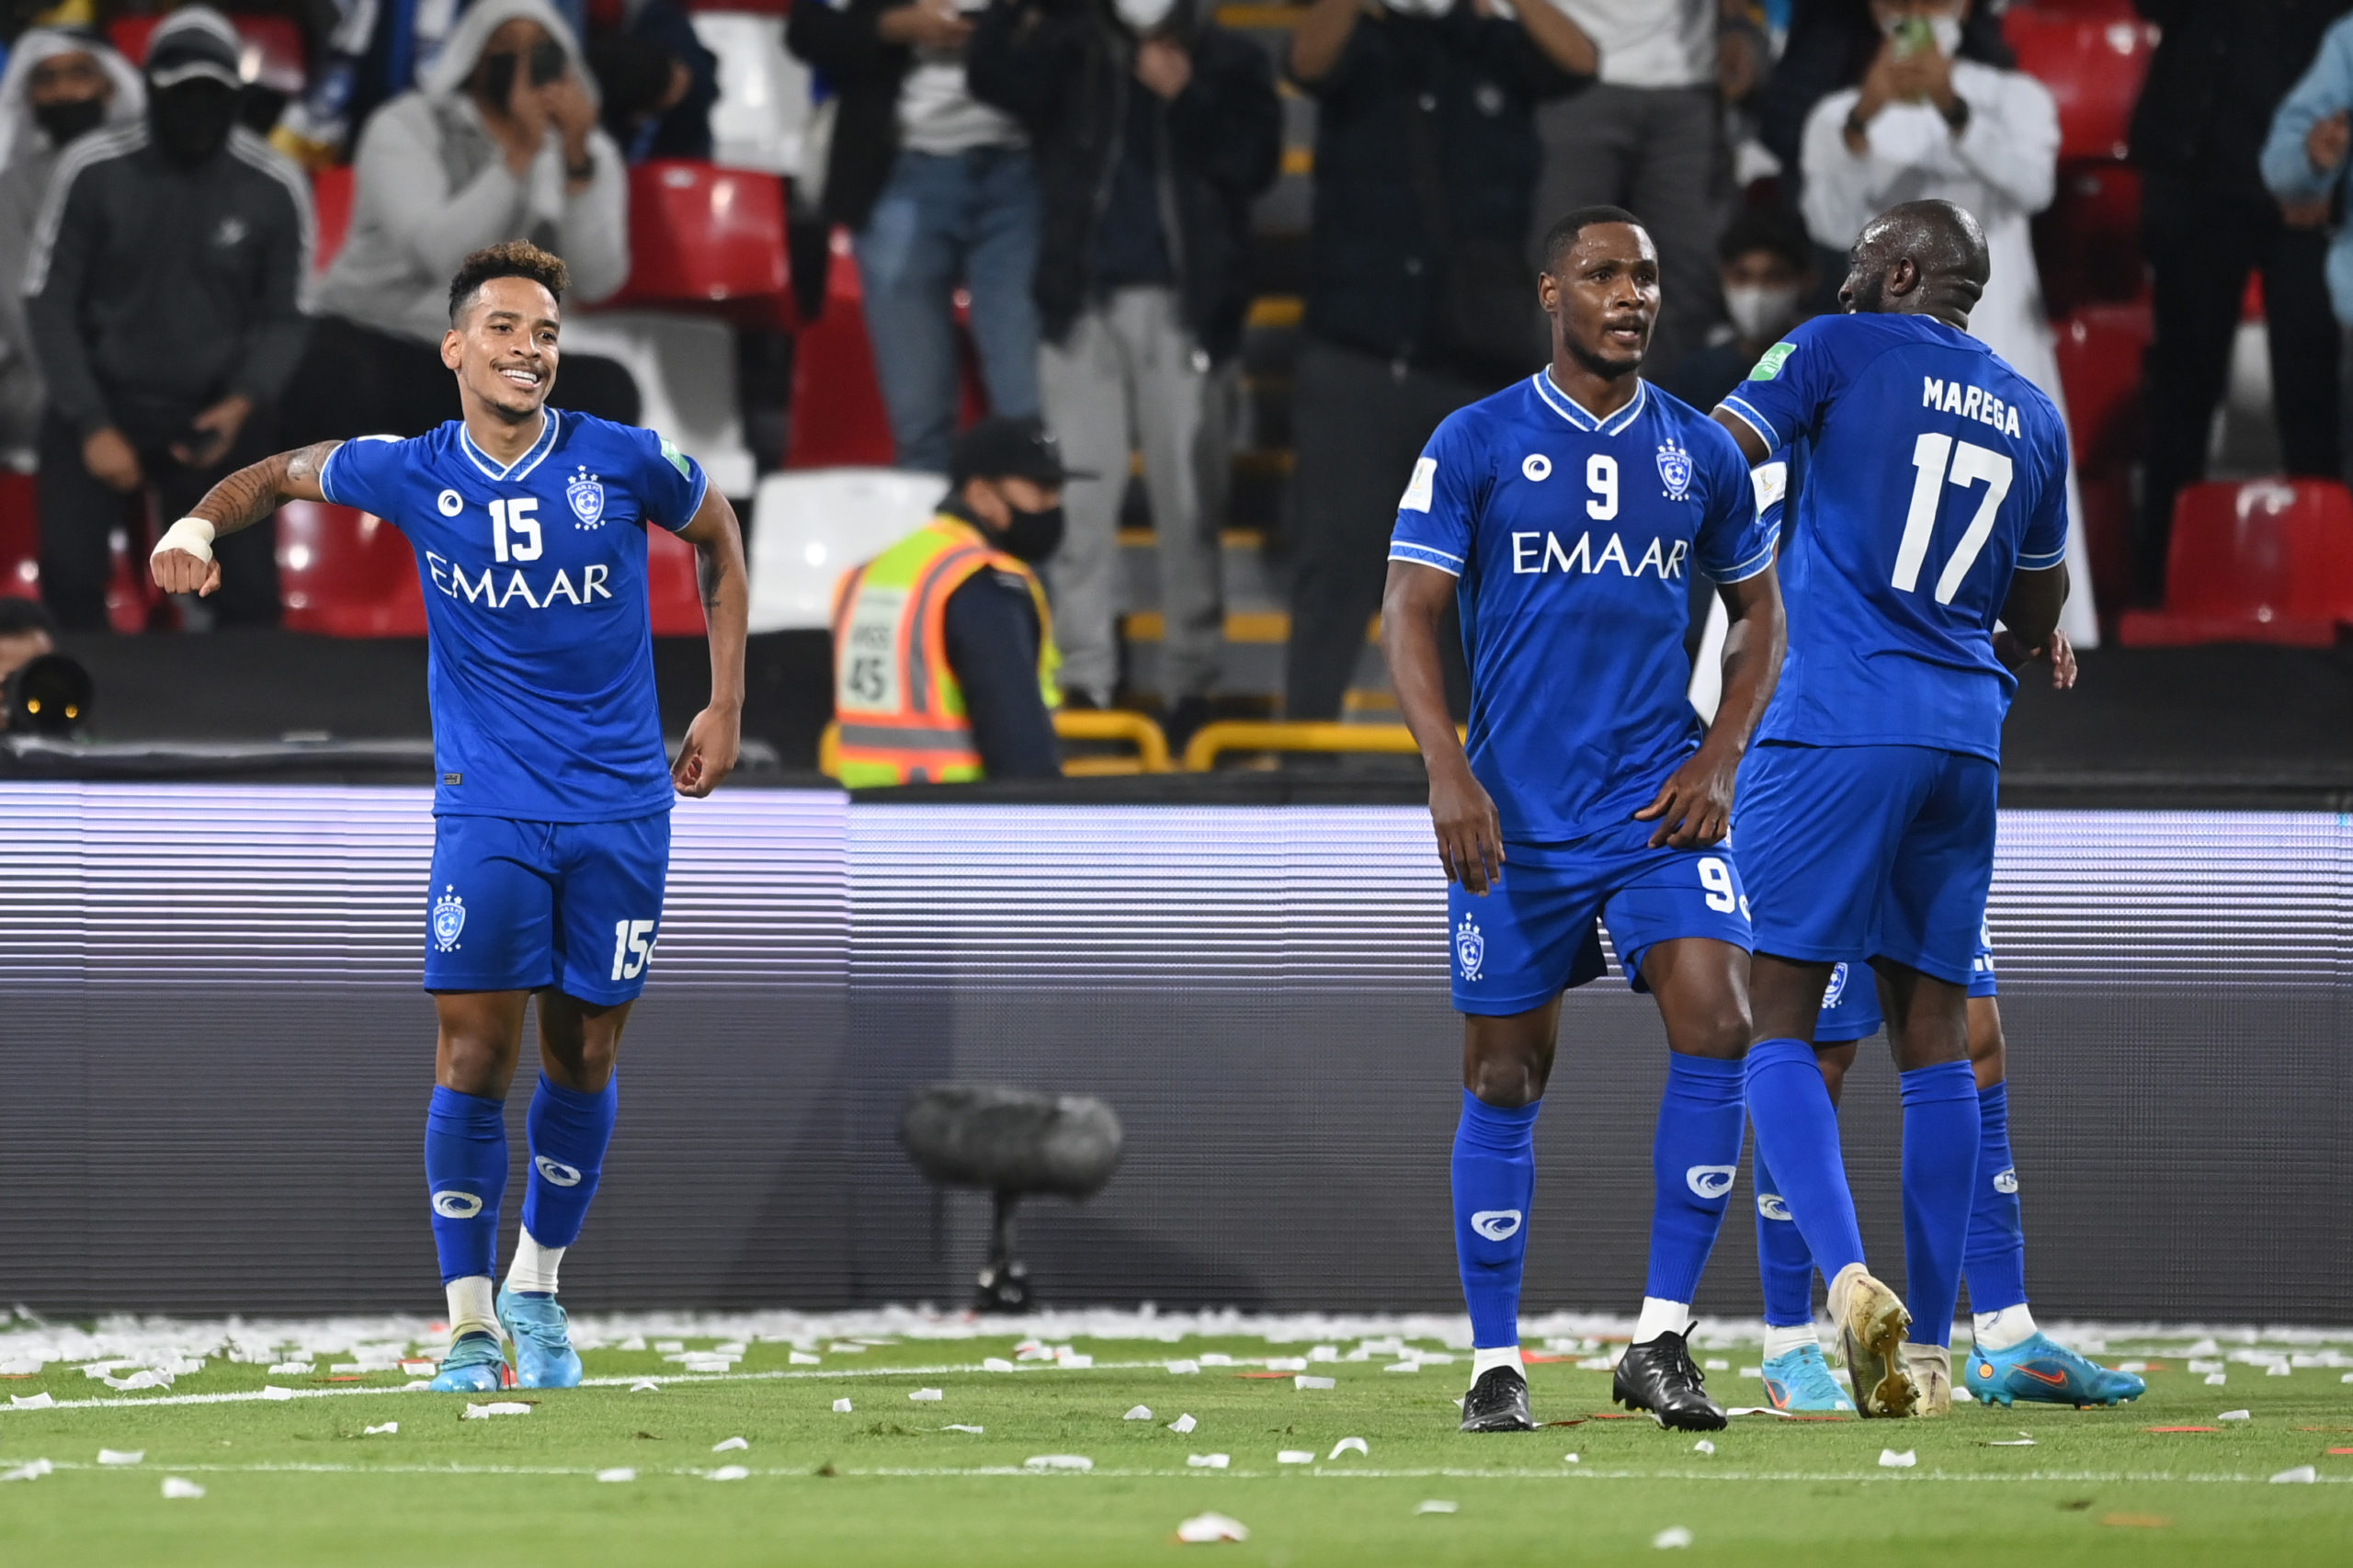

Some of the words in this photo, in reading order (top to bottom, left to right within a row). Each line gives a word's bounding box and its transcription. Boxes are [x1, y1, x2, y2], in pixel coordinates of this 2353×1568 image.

[1923, 376, 2021, 438] MAREGA
[1586, 454, 1619, 521] 9
[489, 498, 542, 562] 15
[1892, 433, 2013, 605] 17
[426, 551, 612, 608] EMAAR
[1512, 530, 1688, 579] EMAAR
[1698, 858, 1736, 914] 9
[611, 920, 654, 981] 15
